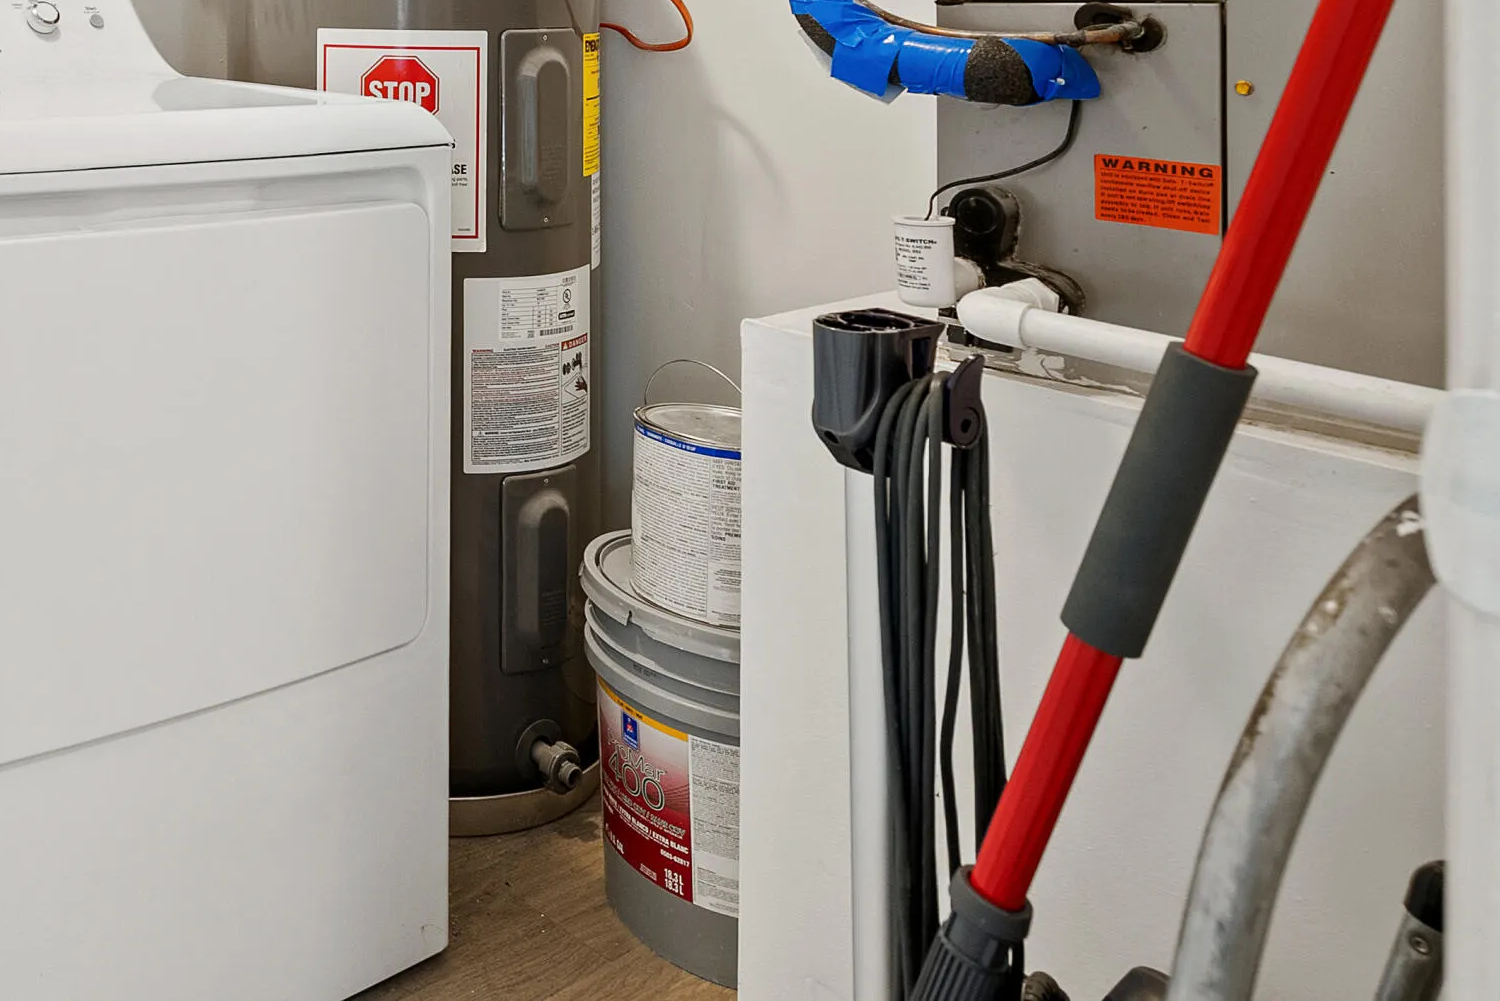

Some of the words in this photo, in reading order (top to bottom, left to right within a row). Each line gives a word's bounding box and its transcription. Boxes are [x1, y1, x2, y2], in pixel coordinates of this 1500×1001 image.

[368, 80, 431, 106] STOP
[1101, 158, 1213, 178] WARNING
[567, 334, 588, 348] DANGER
[608, 748, 665, 812] 400
[652, 831, 670, 846] EXTRA
[670, 840, 690, 855] BLANC
[664, 868, 678, 883] 18.3
[664, 878, 679, 893] 18.3
